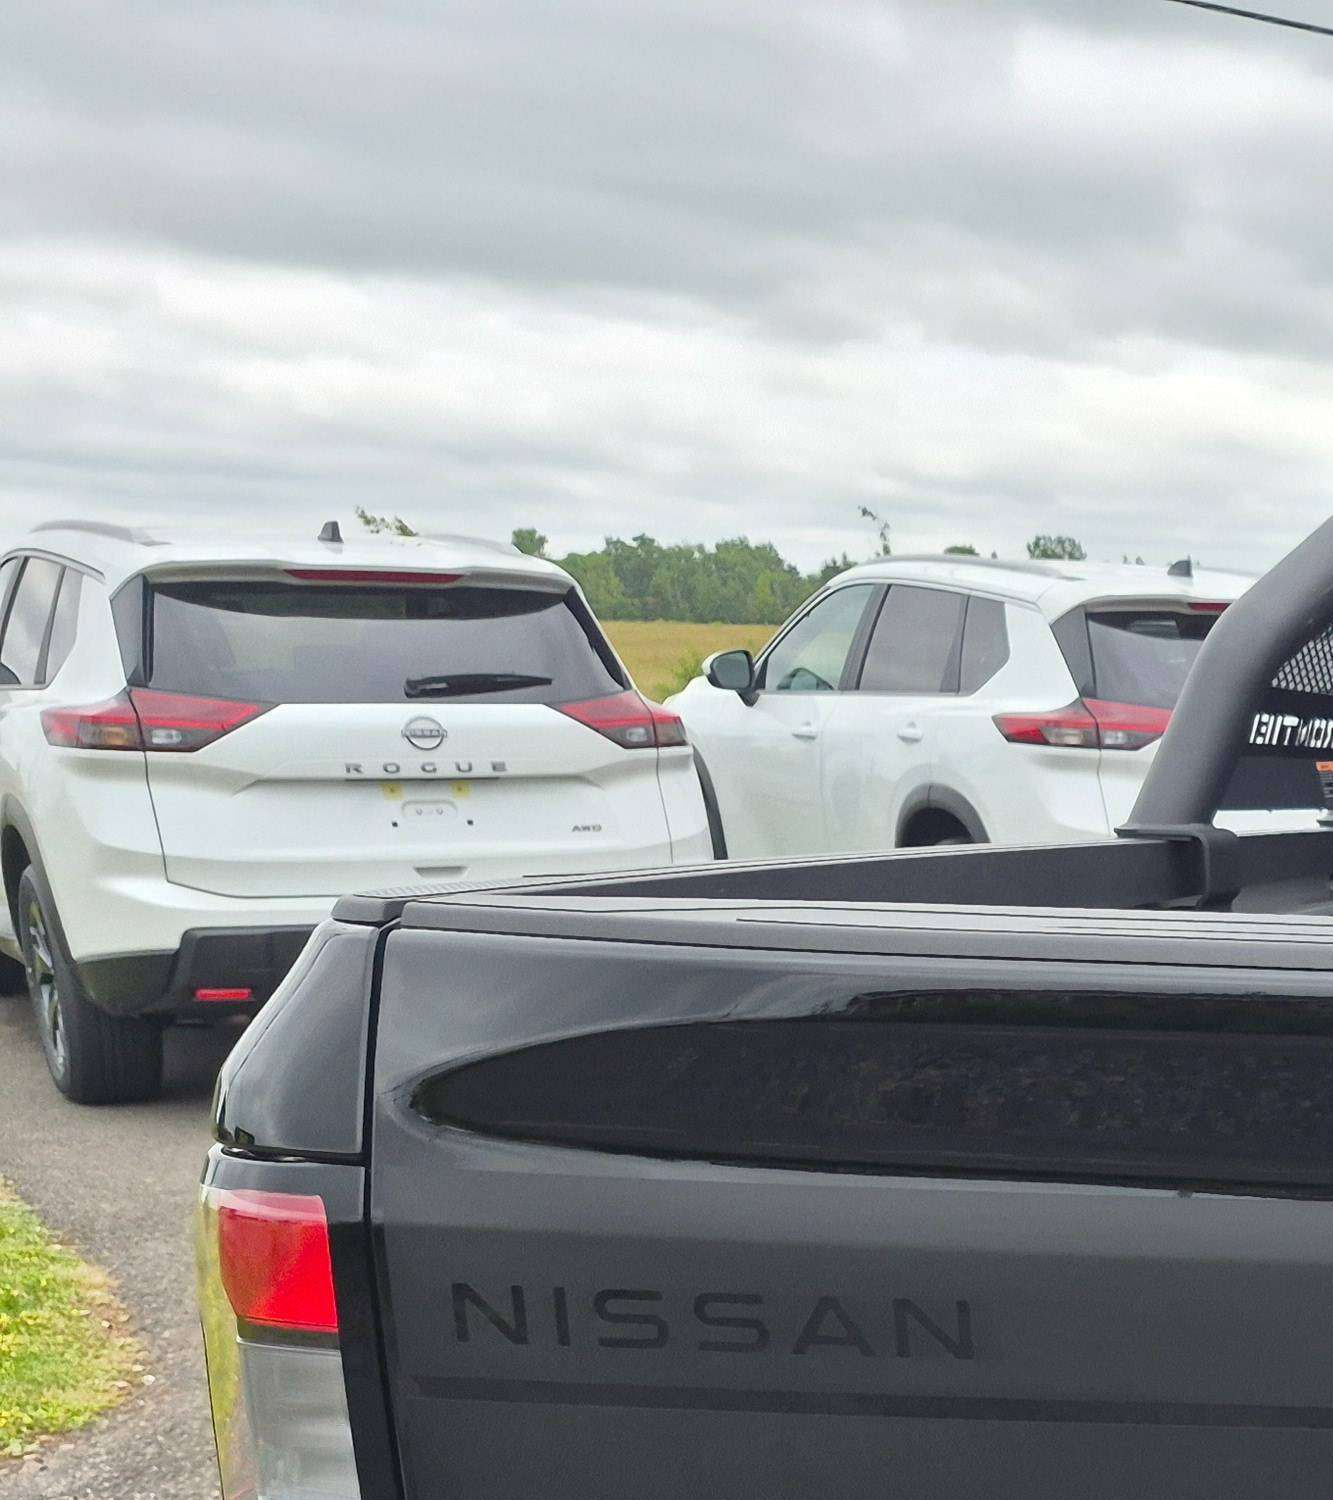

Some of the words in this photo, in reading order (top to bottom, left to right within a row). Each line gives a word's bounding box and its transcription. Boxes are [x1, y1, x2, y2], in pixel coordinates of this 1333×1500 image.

[345, 761, 507, 774] ROGUE
[572, 823, 602, 832] AWD
[451, 1282, 975, 1360] NISSAN
